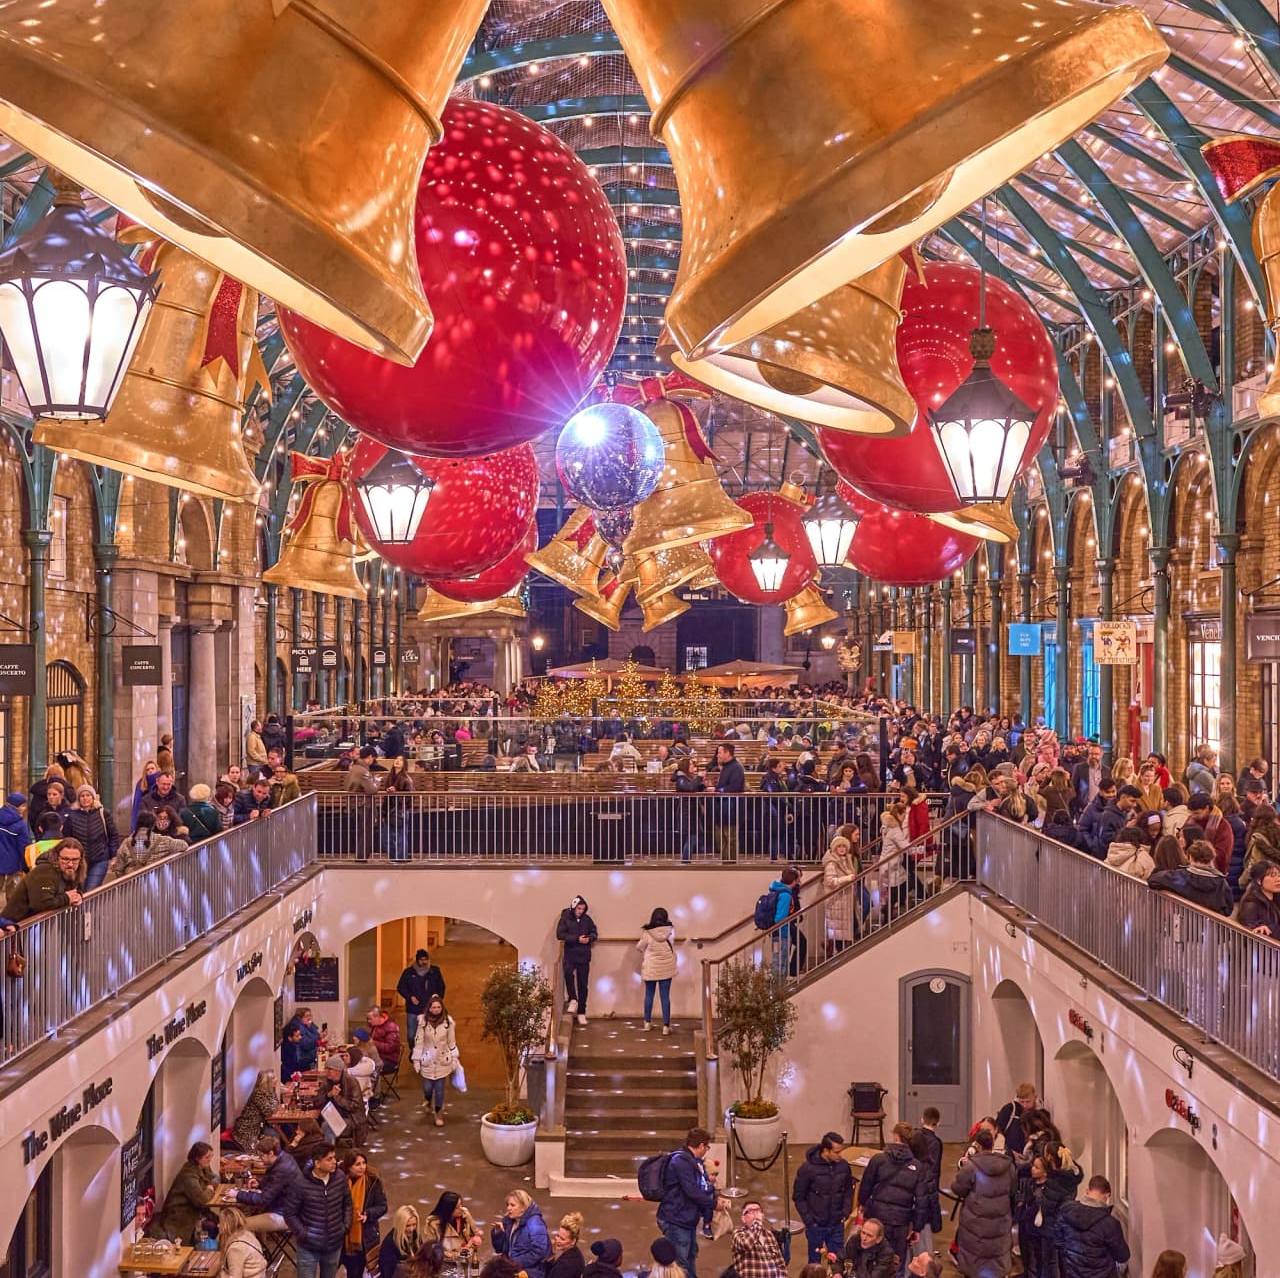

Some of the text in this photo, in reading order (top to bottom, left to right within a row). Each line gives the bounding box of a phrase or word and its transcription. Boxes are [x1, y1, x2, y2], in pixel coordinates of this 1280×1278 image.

[146, 1033, 164, 1059] The
[164, 1017, 186, 1045] Wine
[21, 1130, 48, 1166] The
[49, 1103, 82, 1142] Wine
